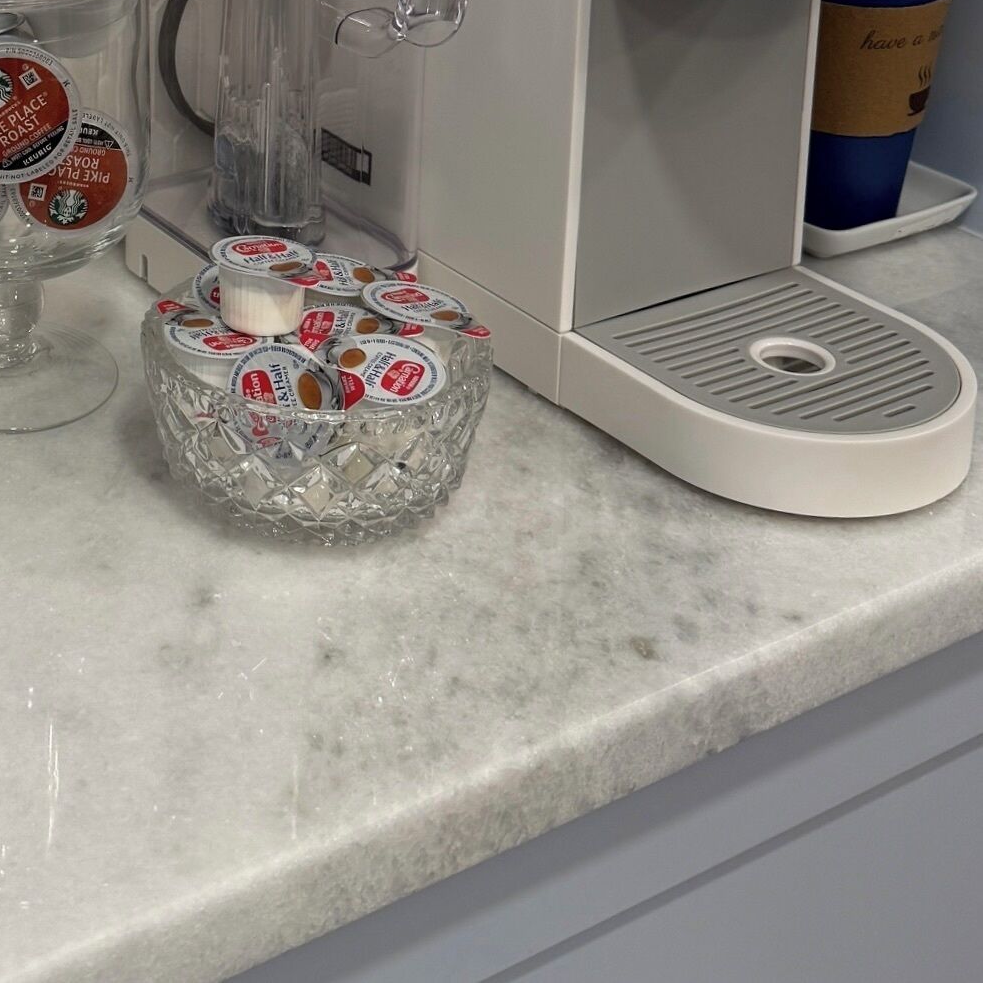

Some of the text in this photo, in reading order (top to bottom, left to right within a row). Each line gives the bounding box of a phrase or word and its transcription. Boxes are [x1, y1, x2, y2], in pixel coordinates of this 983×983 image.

[860, 30, 923, 50] have a
[8, 94, 48, 127] PLACE
[0, 114, 40, 148] ROAST
[2, 122, 53, 157] GROUND COFFEE
[23, 142, 53, 166] KEURIG
[83, 170, 111, 184] PIKE
[381, 351, 397, 368] Half
[268, 363, 290, 403] & Half
[365, 368, 382, 389] Half
[390, 363, 421, 393] Carnation
